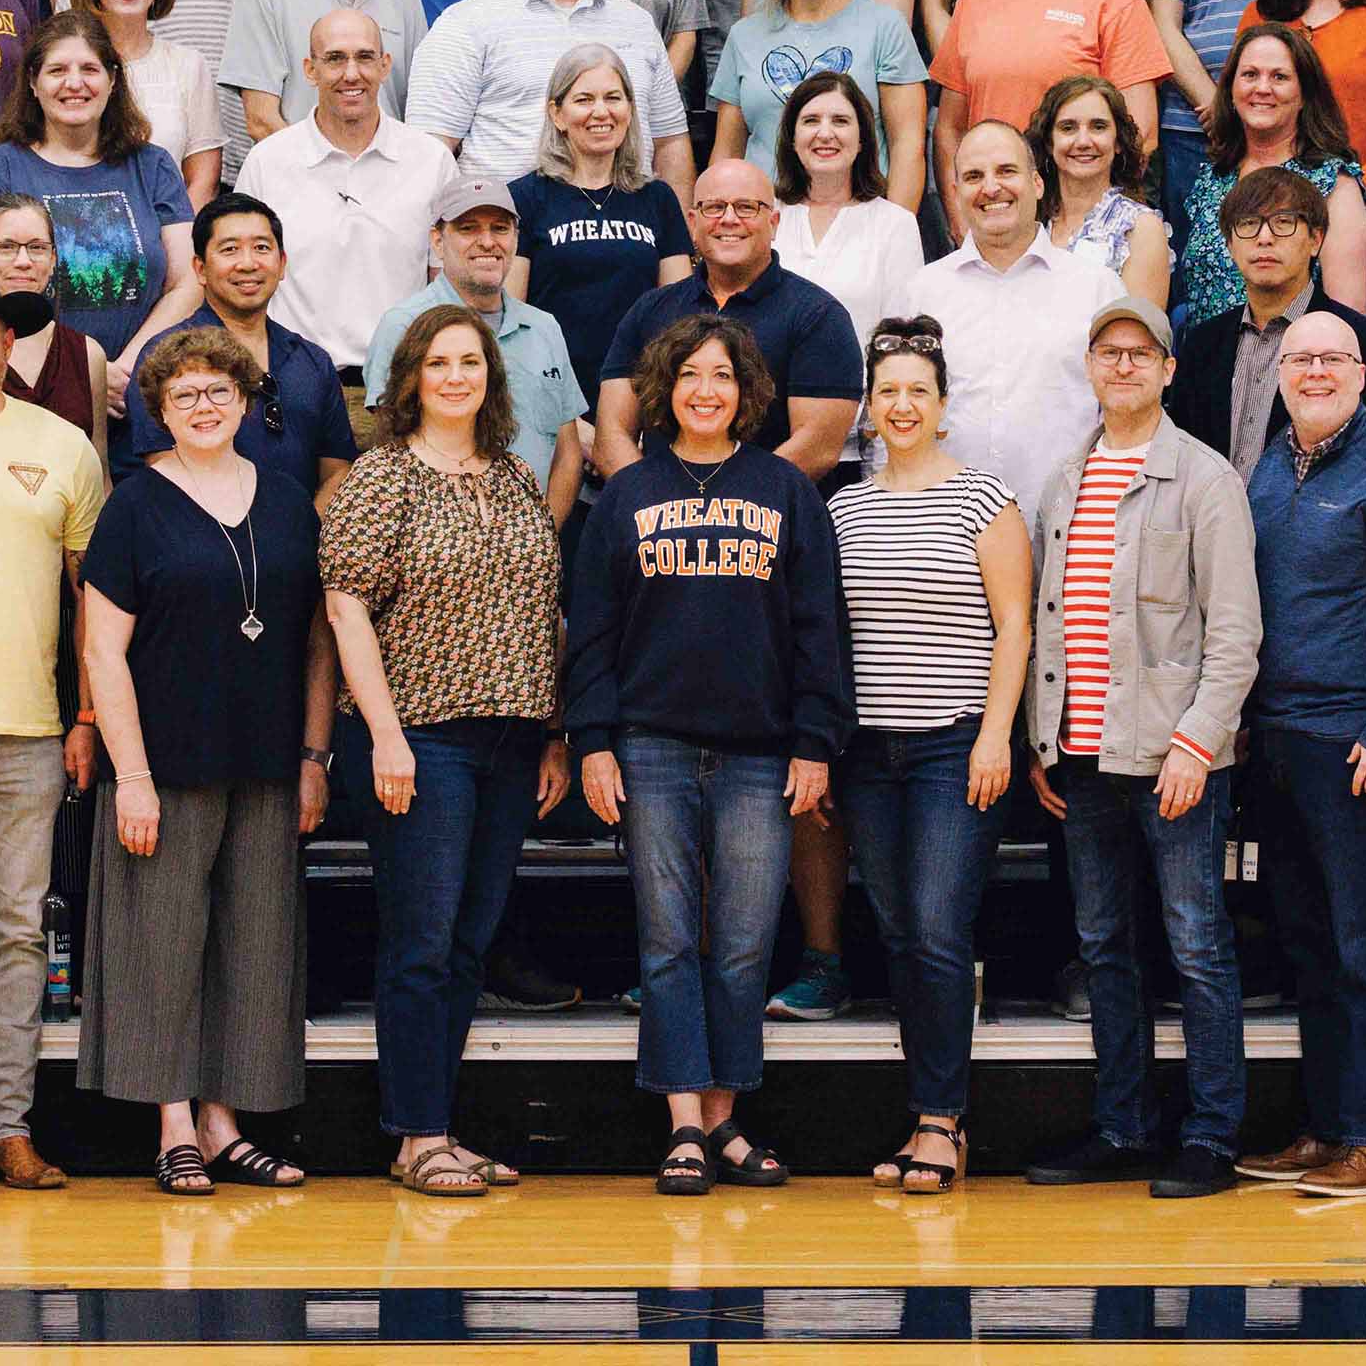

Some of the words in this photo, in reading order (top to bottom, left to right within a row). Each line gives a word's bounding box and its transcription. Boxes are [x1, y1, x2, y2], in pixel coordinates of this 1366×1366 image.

[548, 219, 656, 248] WHEATON
[634, 497, 782, 545] WHEATON
[638, 538, 777, 581] COLLEGE
